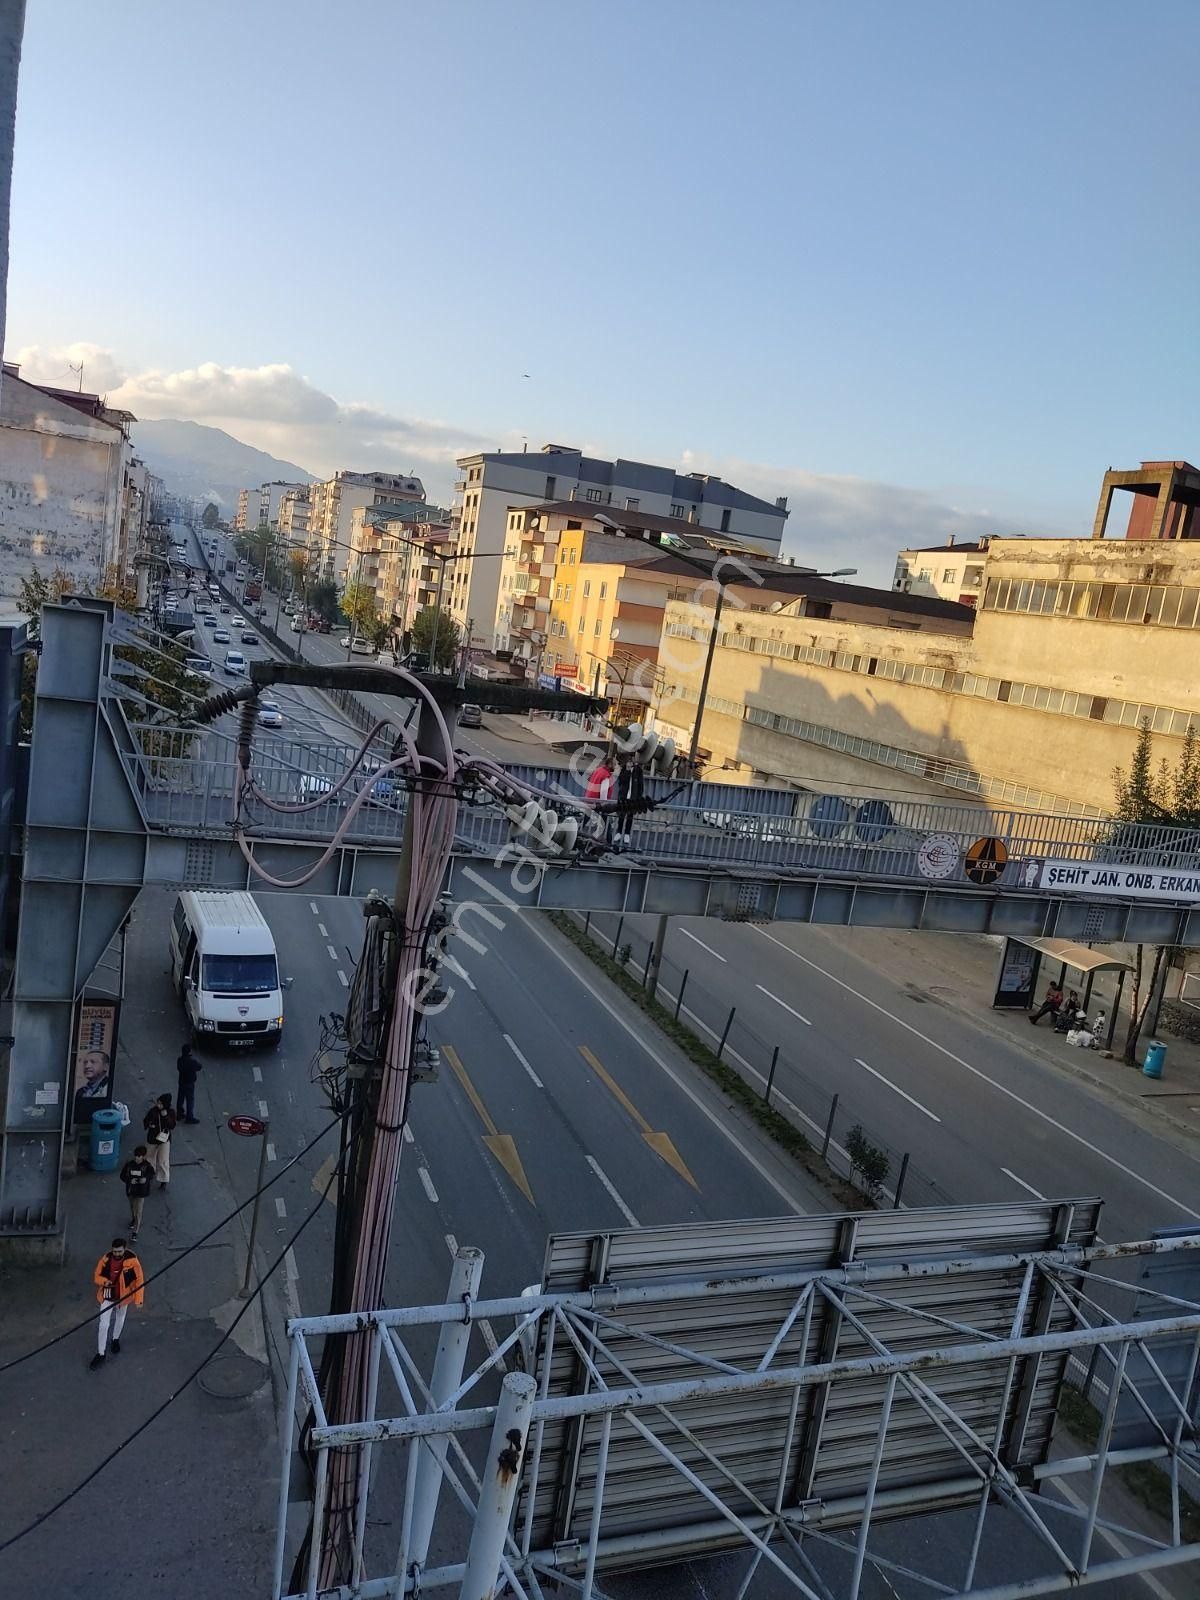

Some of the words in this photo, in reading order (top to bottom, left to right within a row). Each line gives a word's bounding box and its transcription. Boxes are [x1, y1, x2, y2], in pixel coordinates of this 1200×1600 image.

[975, 861, 997, 870] KGM
[1048, 866, 1090, 887] ŞEHİT
[1091, 871, 1121, 888] JAN.
[1125, 873, 1156, 890] ONB.
[1159, 875, 1200, 893] ERKAN
